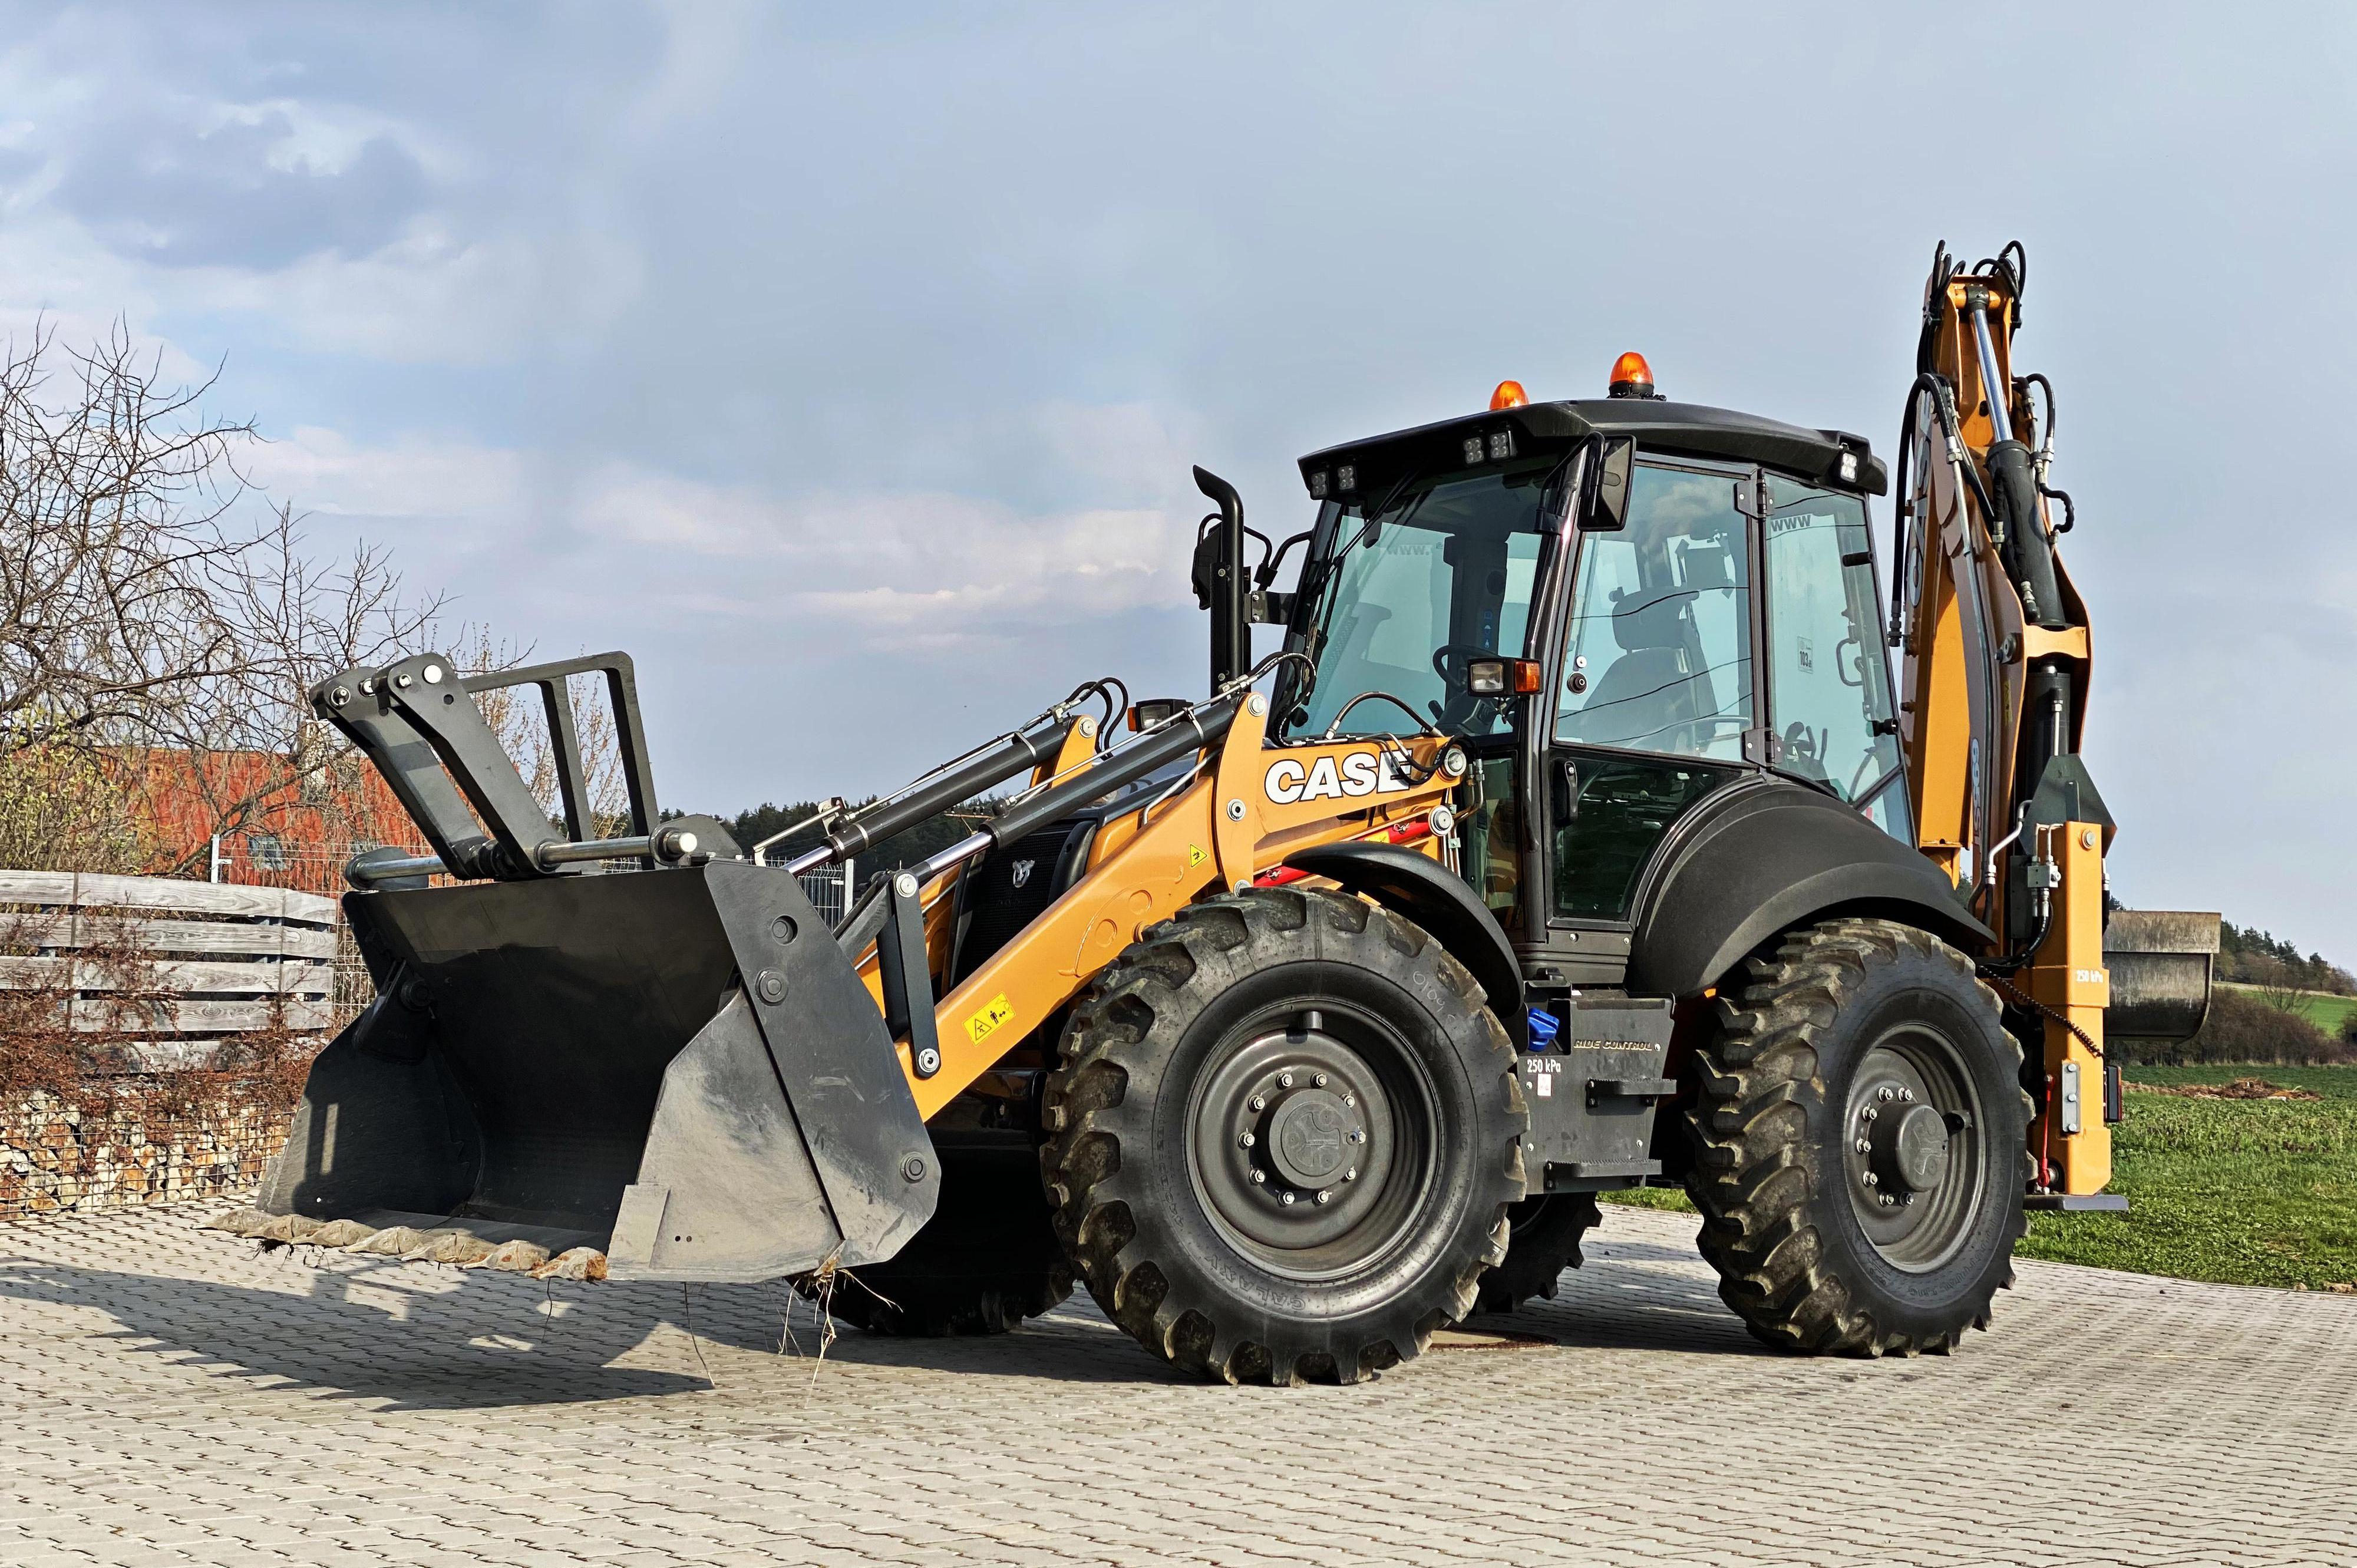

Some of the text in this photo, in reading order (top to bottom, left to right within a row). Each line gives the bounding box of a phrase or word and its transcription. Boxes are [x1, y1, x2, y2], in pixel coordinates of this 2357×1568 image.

[1265, 748, 1413, 804] CASE
[2076, 969, 2103, 983] 250 kPa
[1574, 1039, 1652, 1051] RIDE CONTROL
[1527, 1058, 1561, 1073] 250 kPa
[1204, 1254, 1306, 1311] GALAXY
